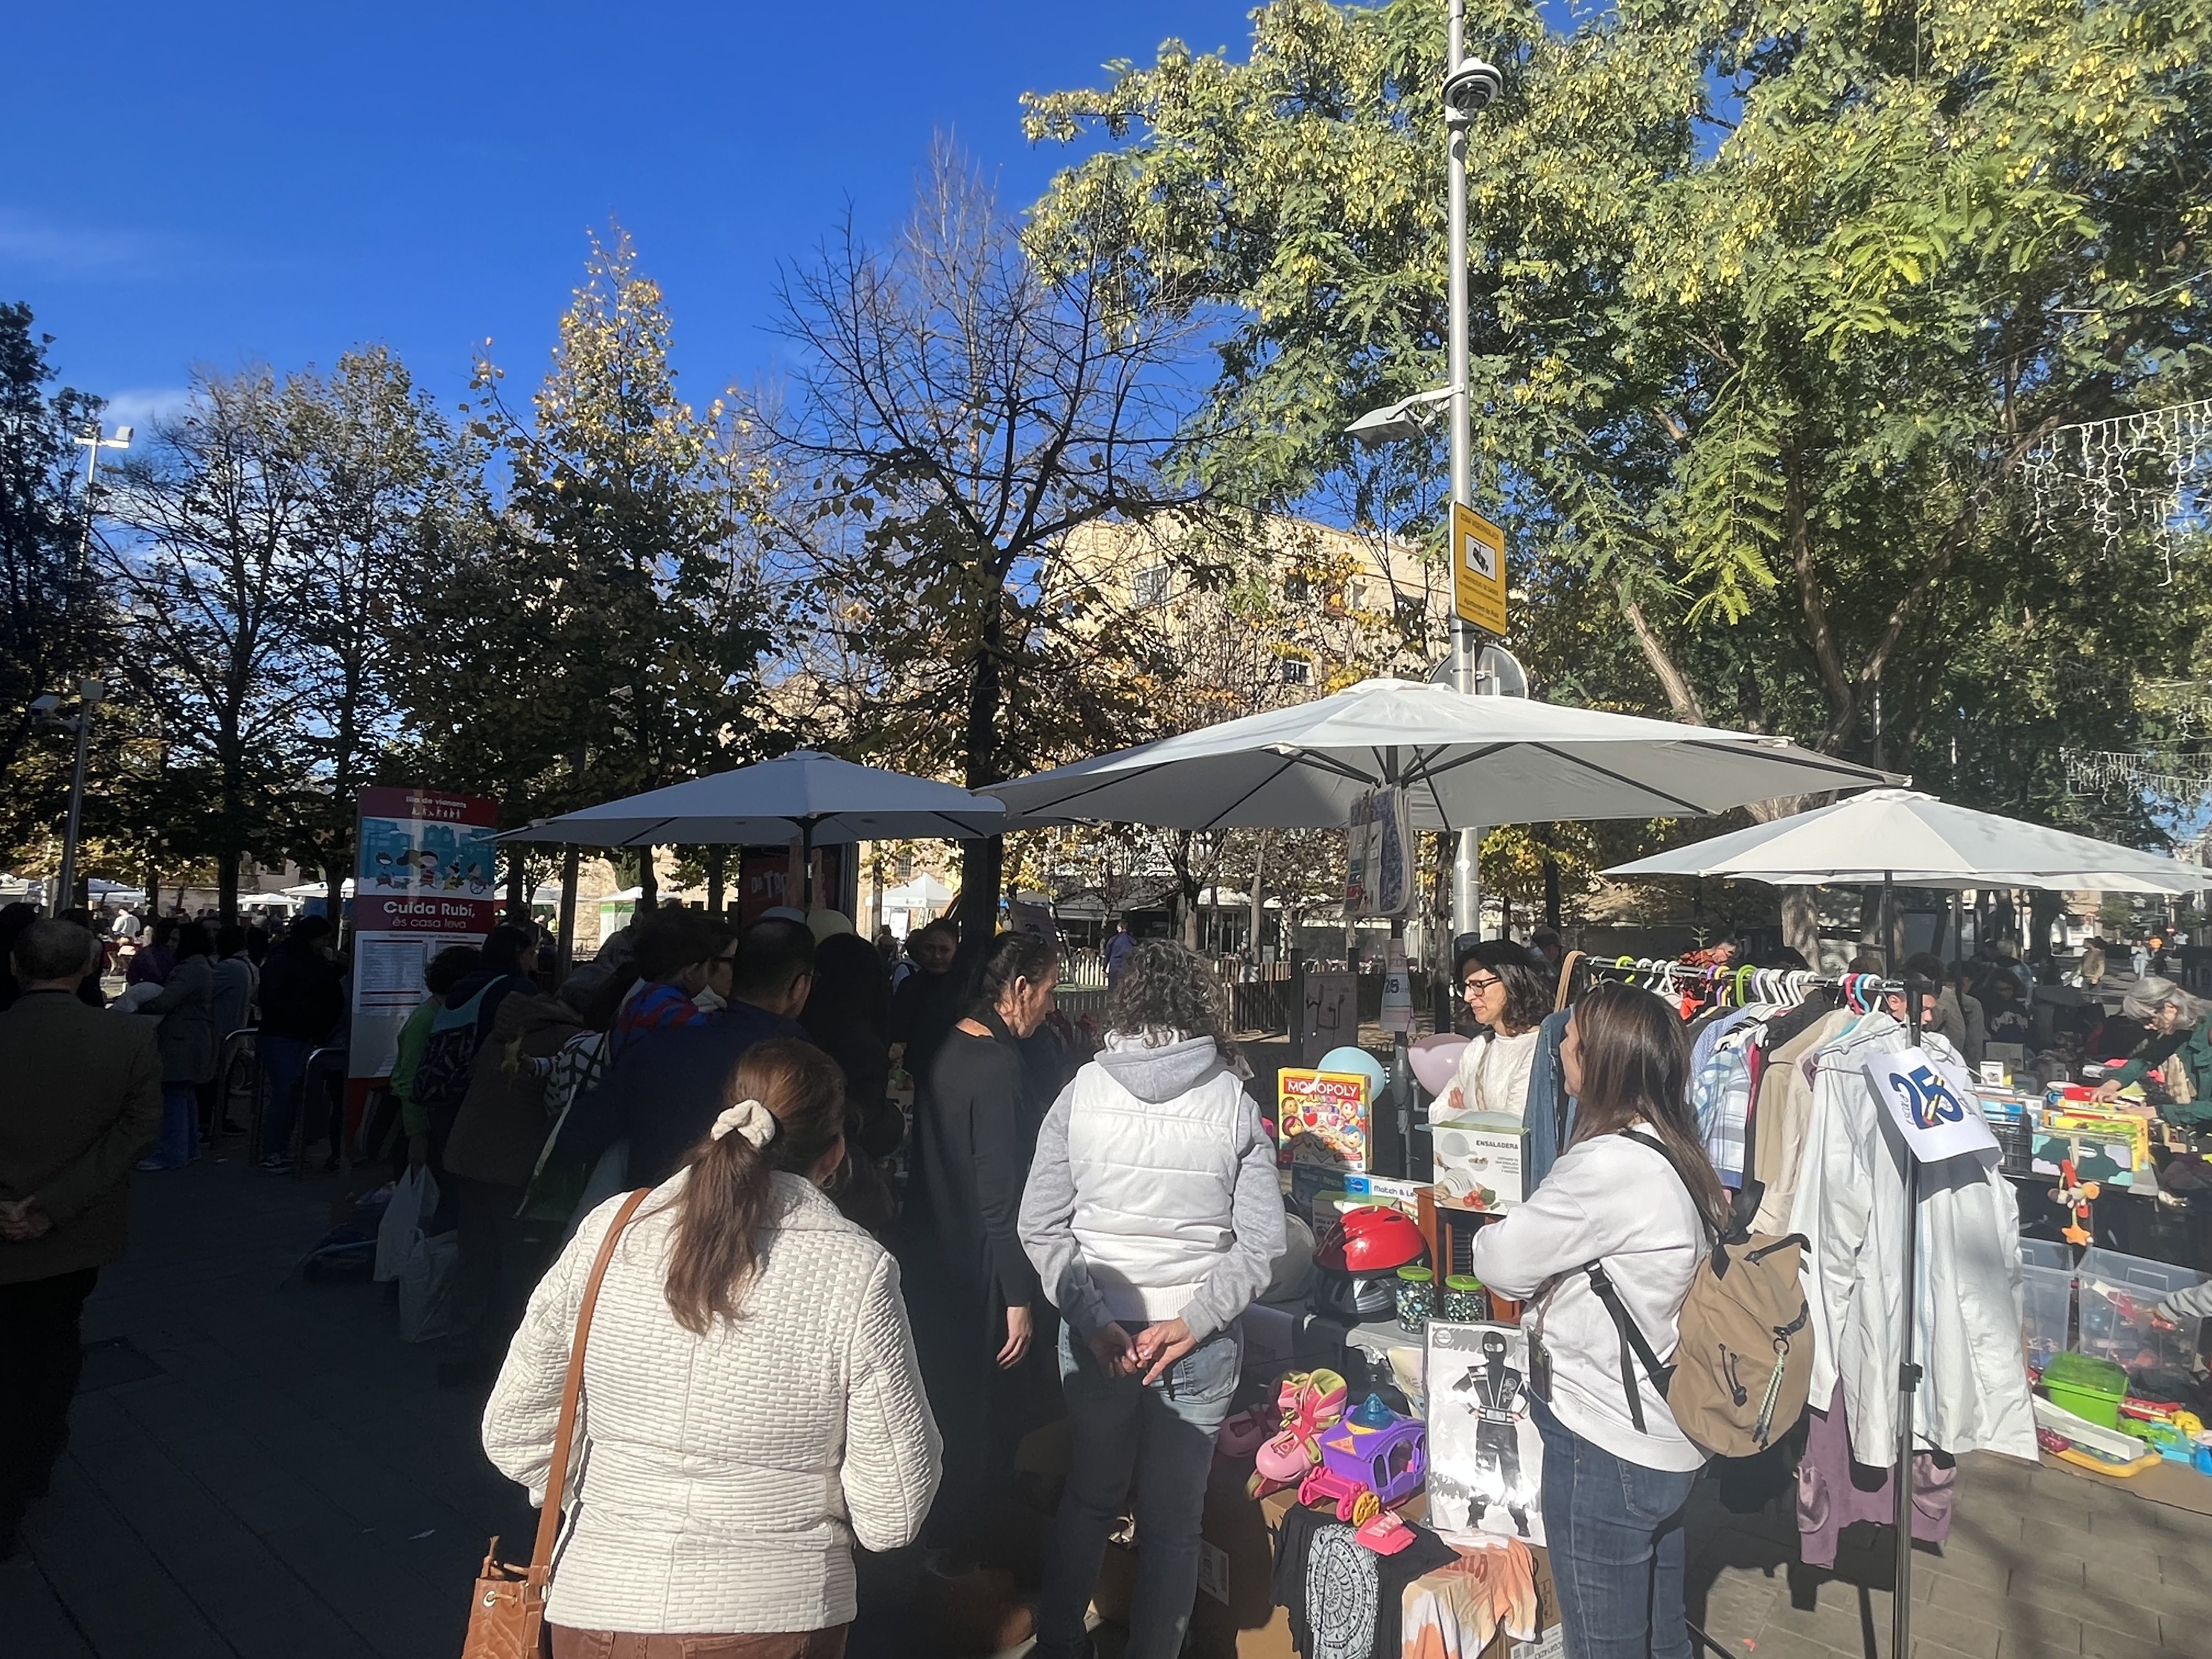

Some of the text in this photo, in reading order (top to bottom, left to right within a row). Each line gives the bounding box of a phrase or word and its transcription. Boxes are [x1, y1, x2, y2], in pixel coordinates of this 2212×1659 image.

[383, 900, 475, 918] Cuida Rubí,
[392, 916, 407, 927] és
[410, 918, 441, 928] casa
[1385, 979, 1400, 994] 25
[1888, 1064, 1964, 1130] 25
[1476, 1140, 1519, 1150] ENSALADERA
[1374, 1184, 1397, 1195] Match
